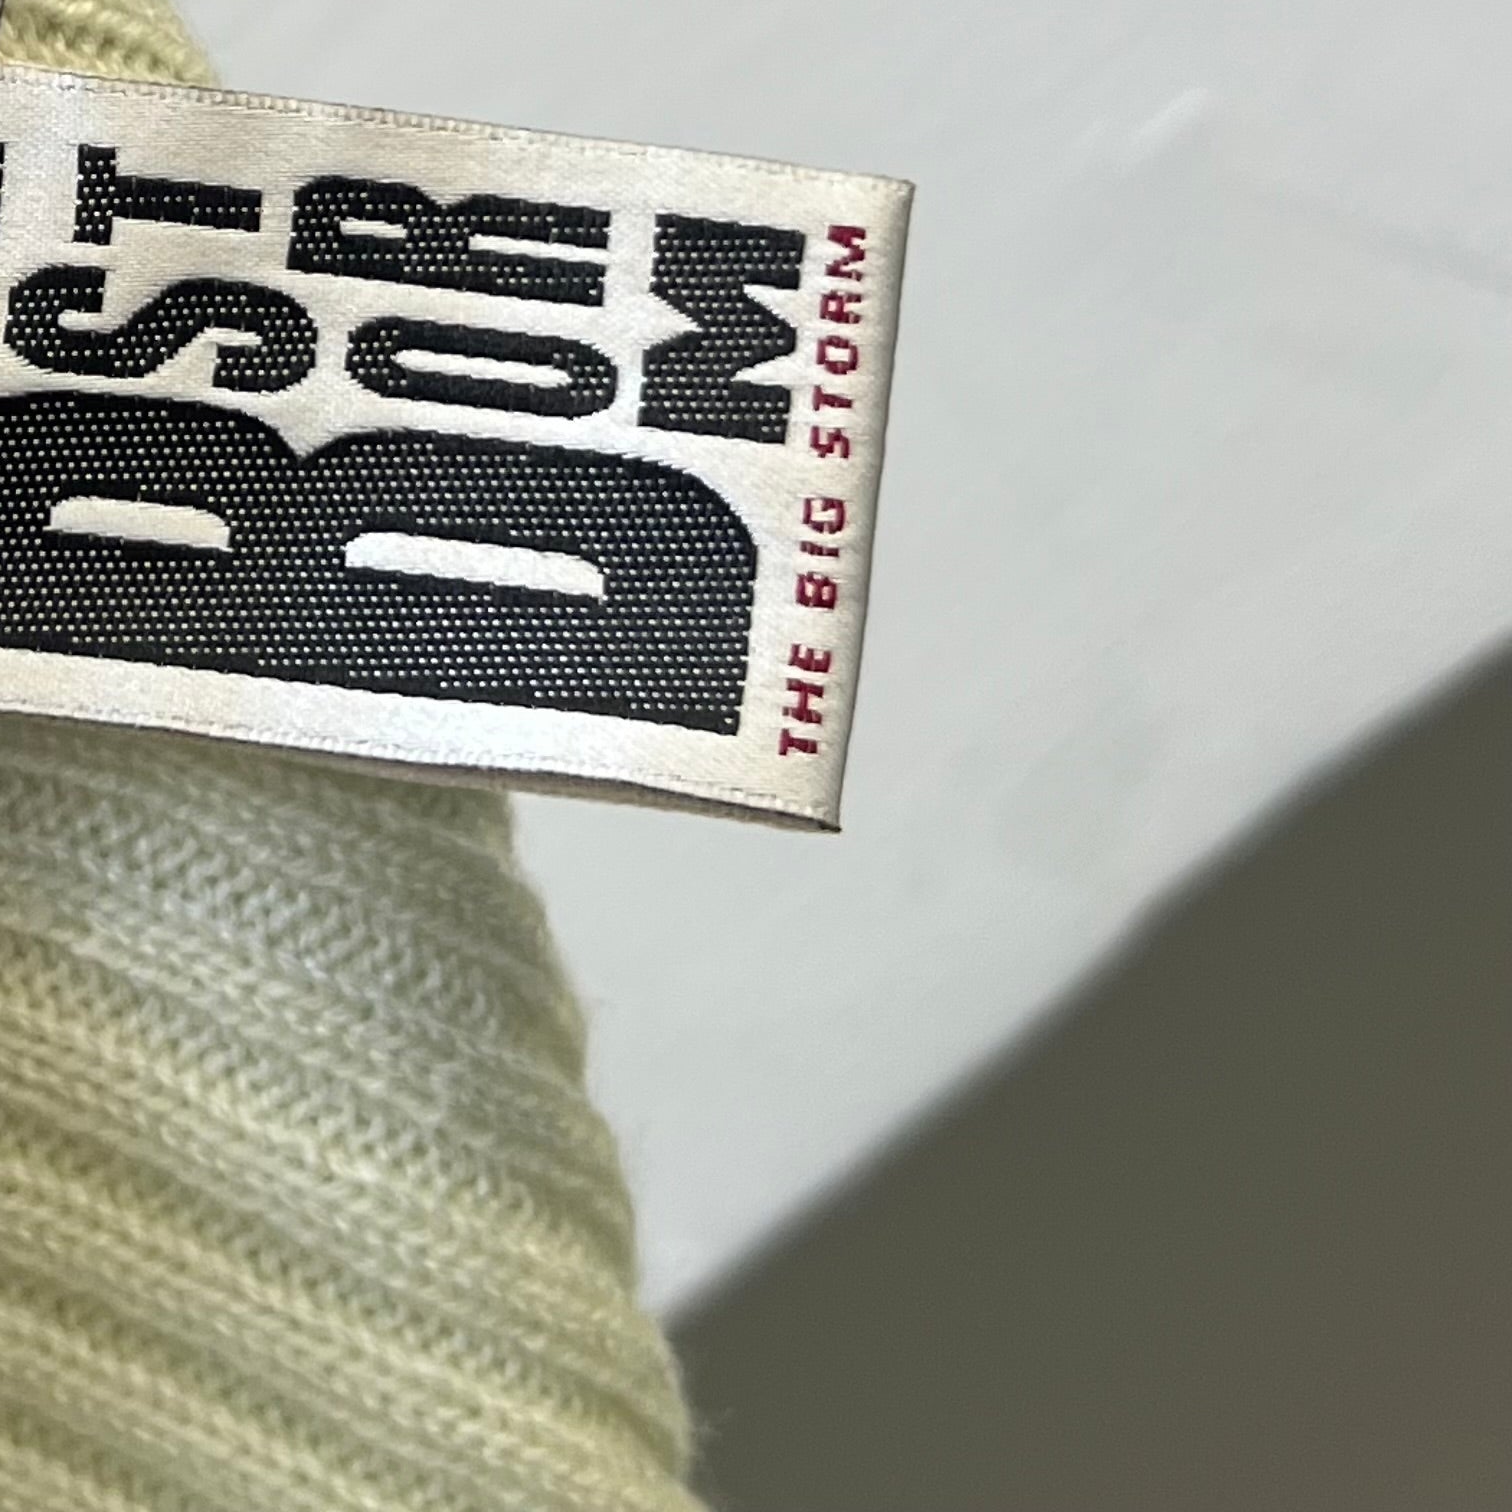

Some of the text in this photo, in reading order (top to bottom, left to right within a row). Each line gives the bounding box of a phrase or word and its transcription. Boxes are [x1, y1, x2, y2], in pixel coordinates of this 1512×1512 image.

[778, 225, 867, 756] THE BIG STORM
